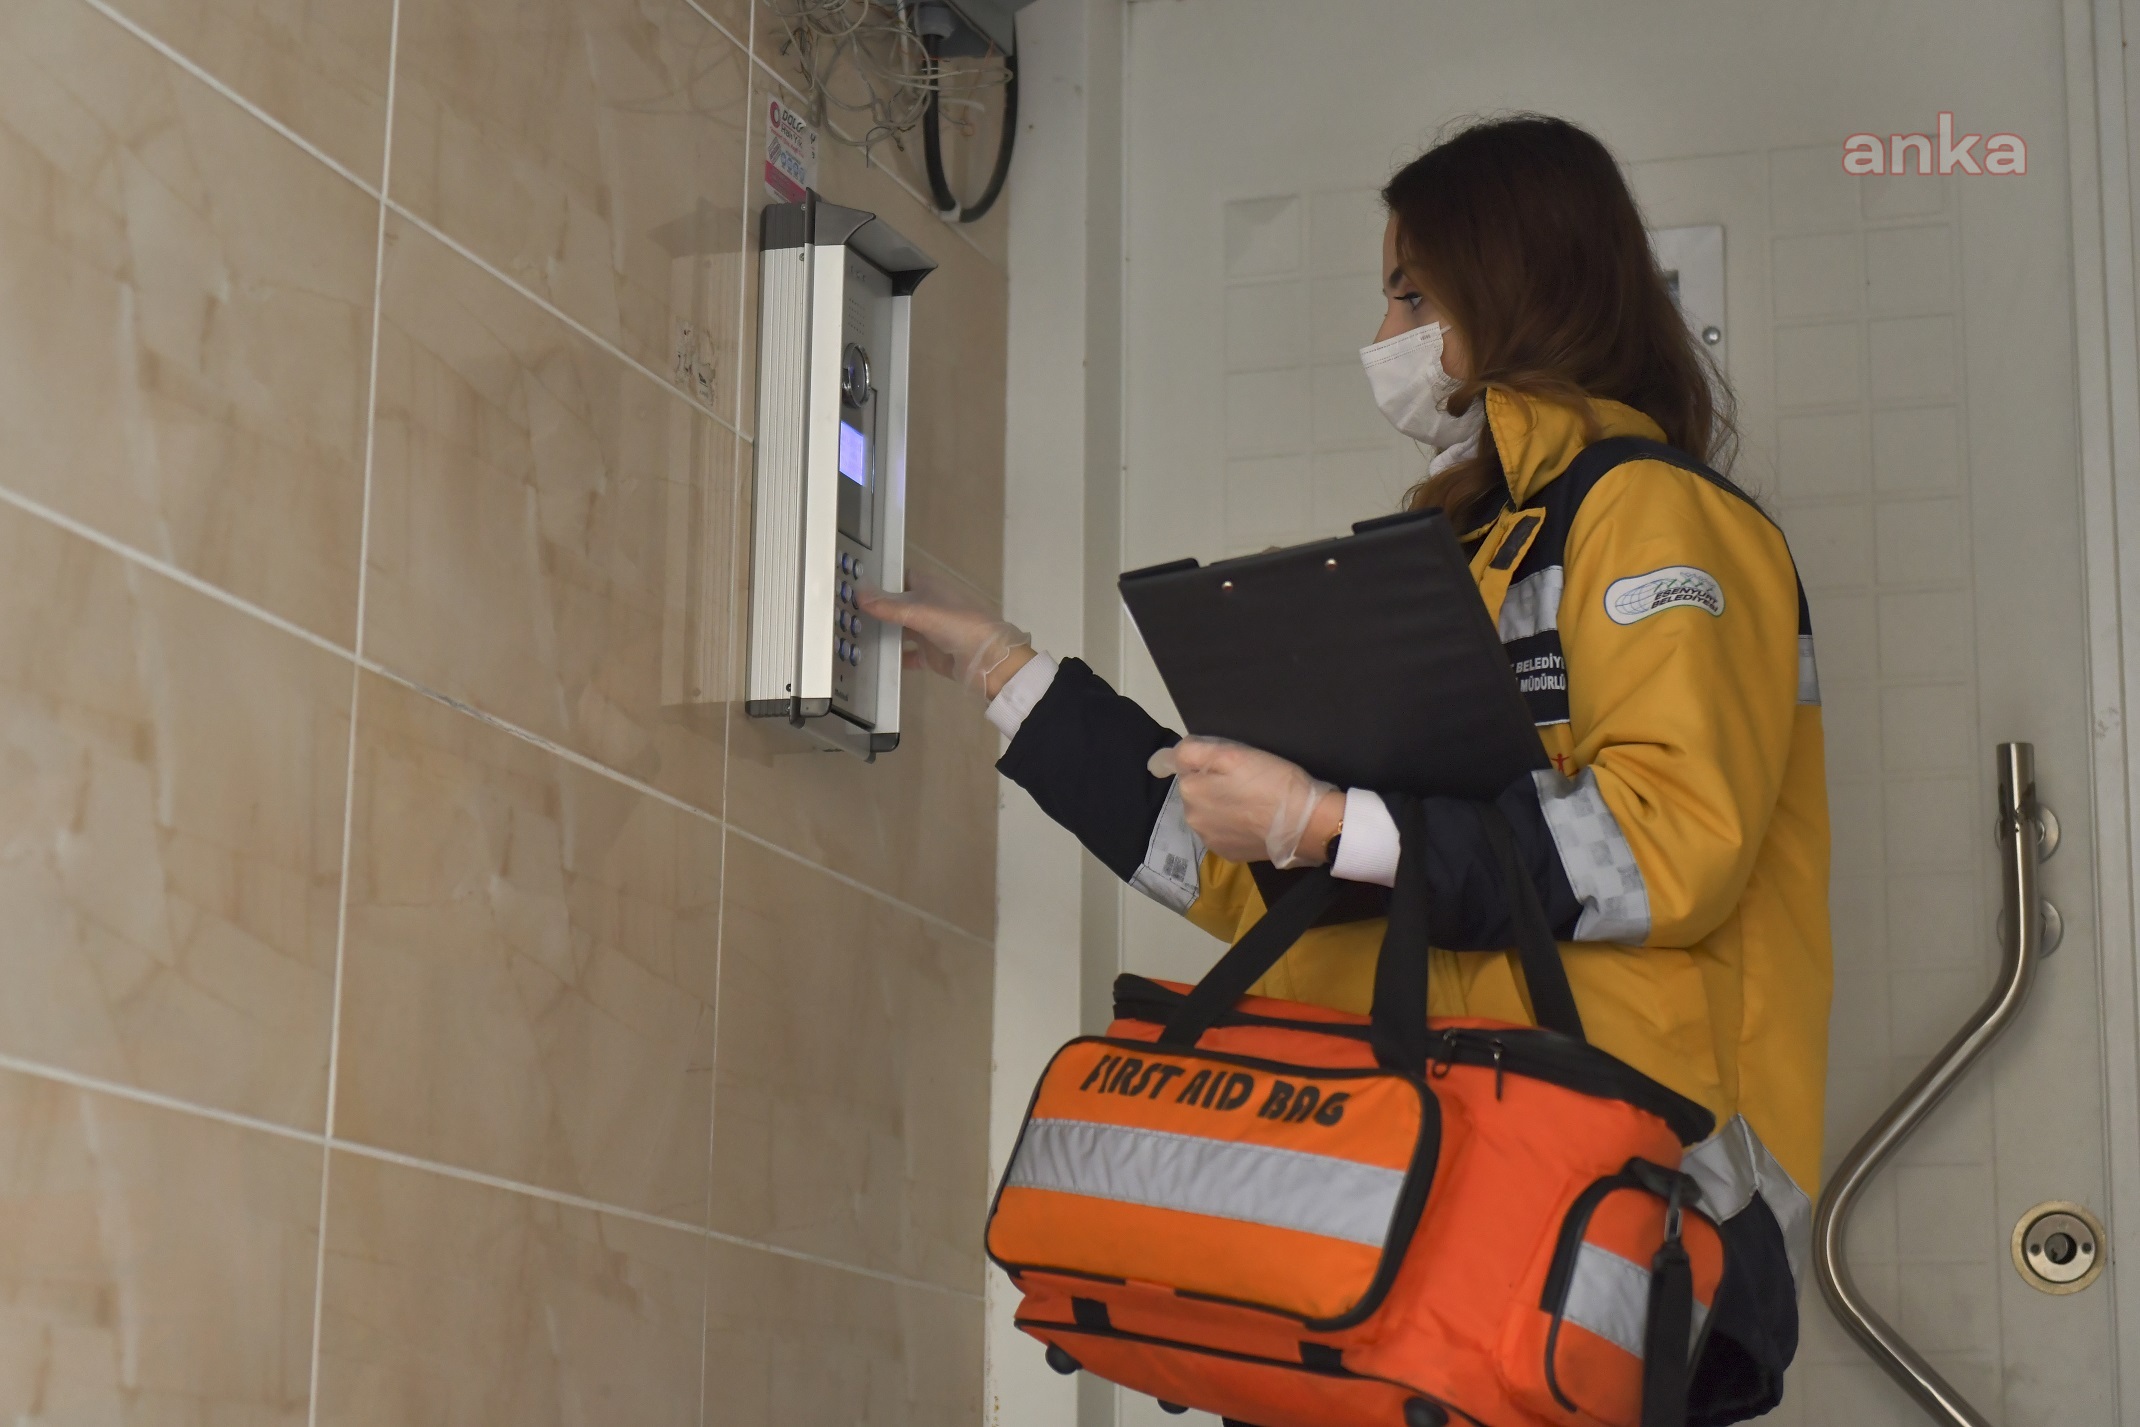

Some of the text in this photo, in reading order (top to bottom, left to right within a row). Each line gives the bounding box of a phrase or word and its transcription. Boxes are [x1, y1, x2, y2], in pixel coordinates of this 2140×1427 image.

[1654, 587, 1718, 604] ESENYURT
[1079, 1054, 1351, 1127] FIRST AID BAG
